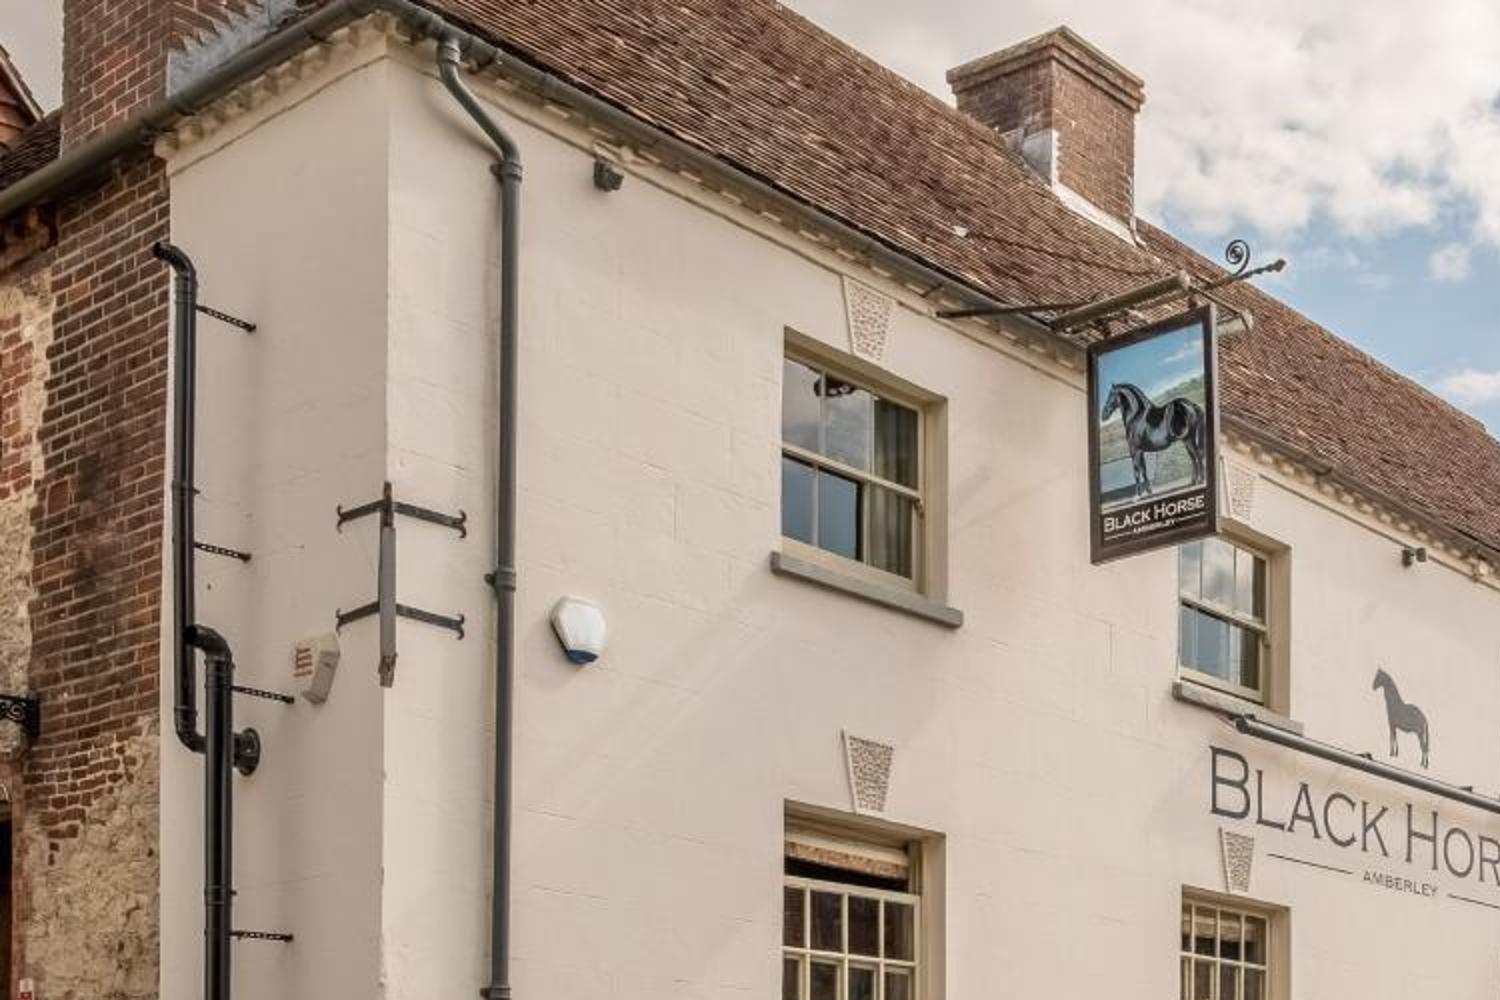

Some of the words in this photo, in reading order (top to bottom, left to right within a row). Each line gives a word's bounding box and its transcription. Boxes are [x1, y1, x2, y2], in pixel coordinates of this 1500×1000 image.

[1103, 508, 1151, 533] BLACK
[1153, 495, 1205, 519] HORSE
[1210, 745, 1389, 857] BLACK
[1363, 870, 1438, 896] AMBERLEY
